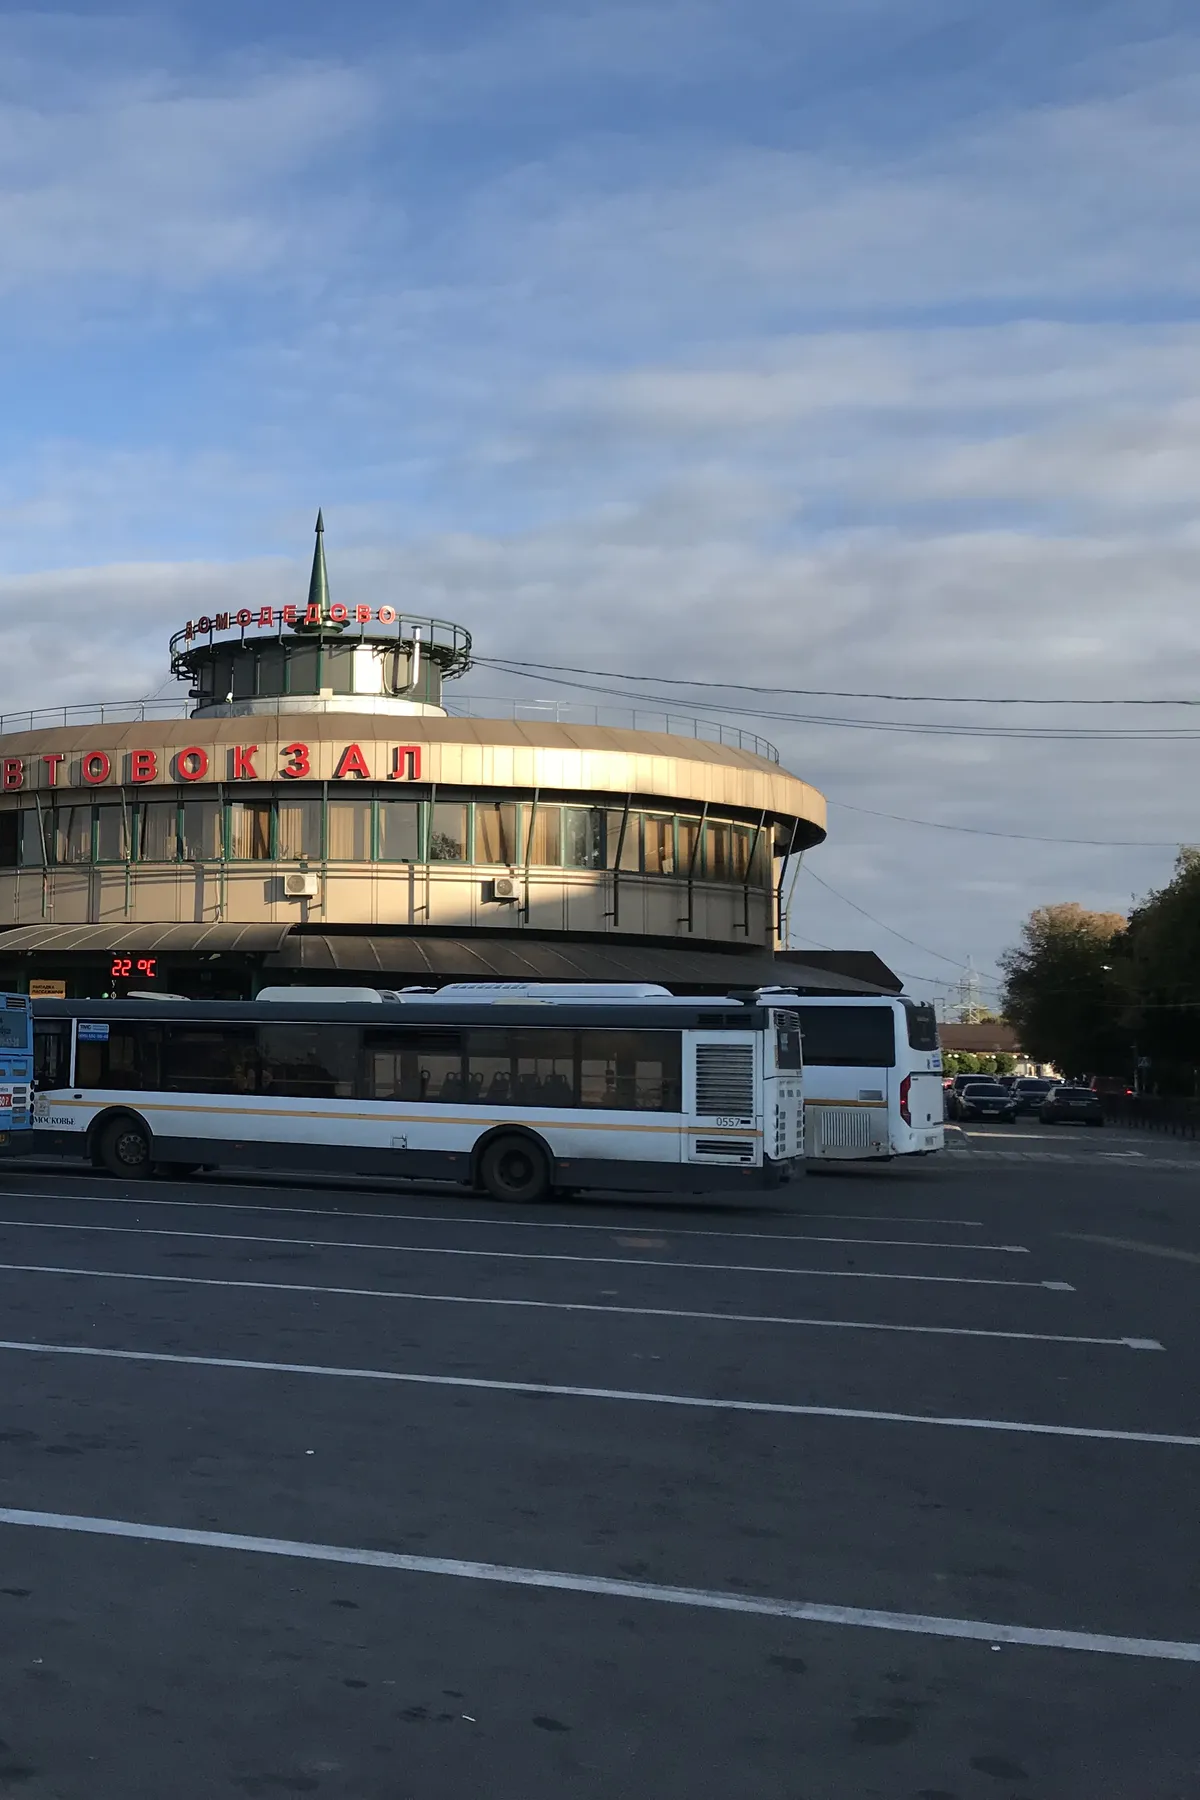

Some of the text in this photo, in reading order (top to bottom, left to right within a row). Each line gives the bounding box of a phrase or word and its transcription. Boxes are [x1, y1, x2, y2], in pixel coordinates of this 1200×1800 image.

[184, 603, 397, 641] ДОМОДЕДОВО
[111, 959, 132, 977] 22
[716, 1117, 740, 1127] 0557
